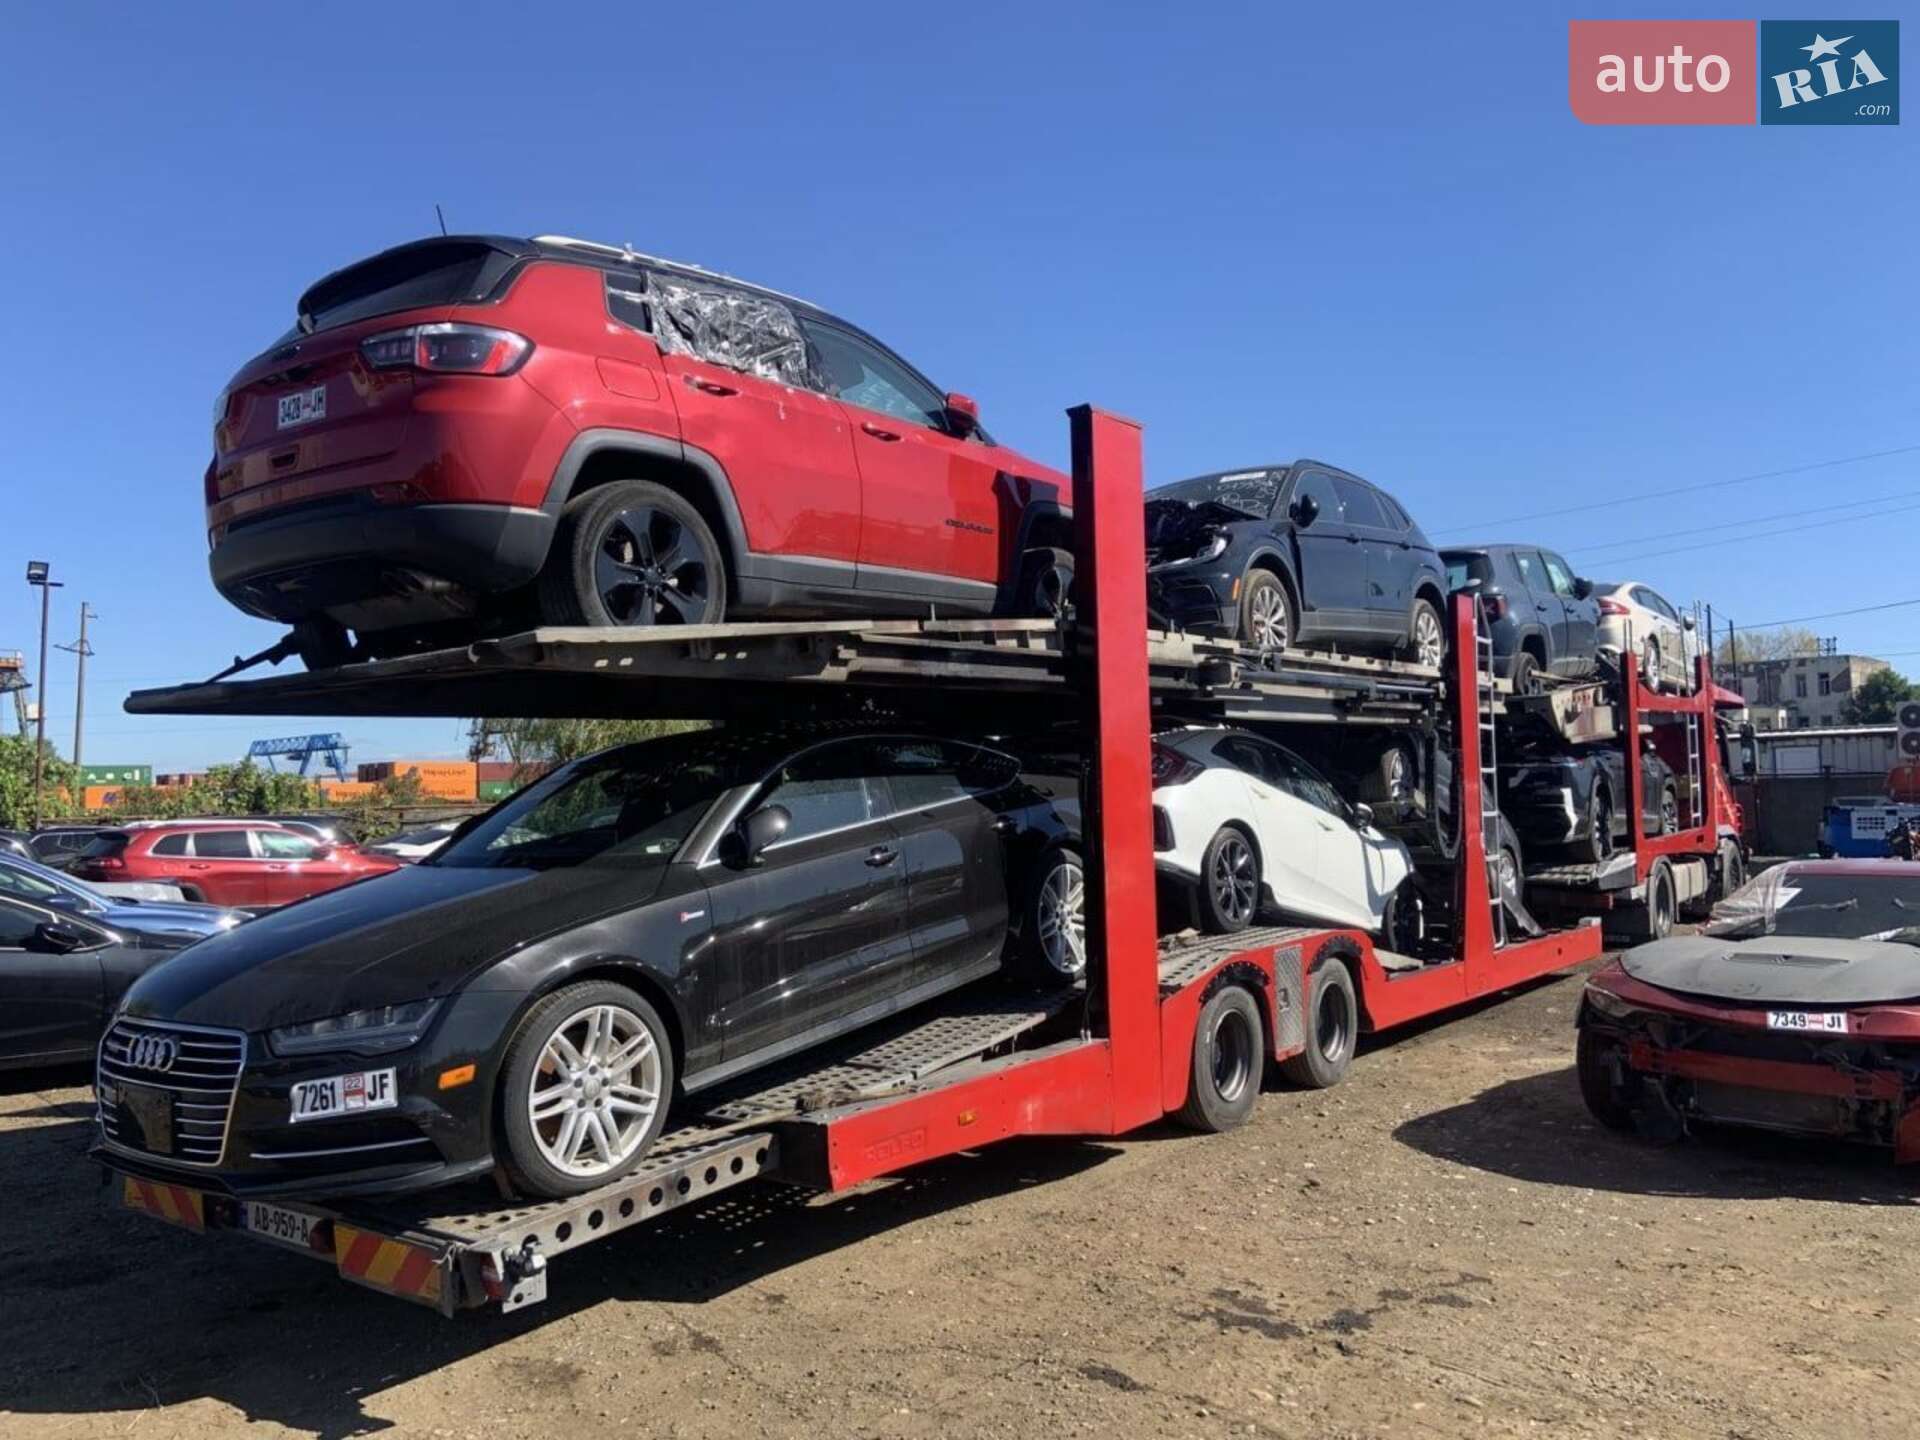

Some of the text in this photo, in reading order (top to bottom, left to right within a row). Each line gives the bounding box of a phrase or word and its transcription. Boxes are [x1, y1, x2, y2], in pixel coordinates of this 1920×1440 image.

[1771, 1012, 1807, 1028] 7349
[298, 1081, 337, 1114] 7261
[367, 1073, 389, 1101] JF
